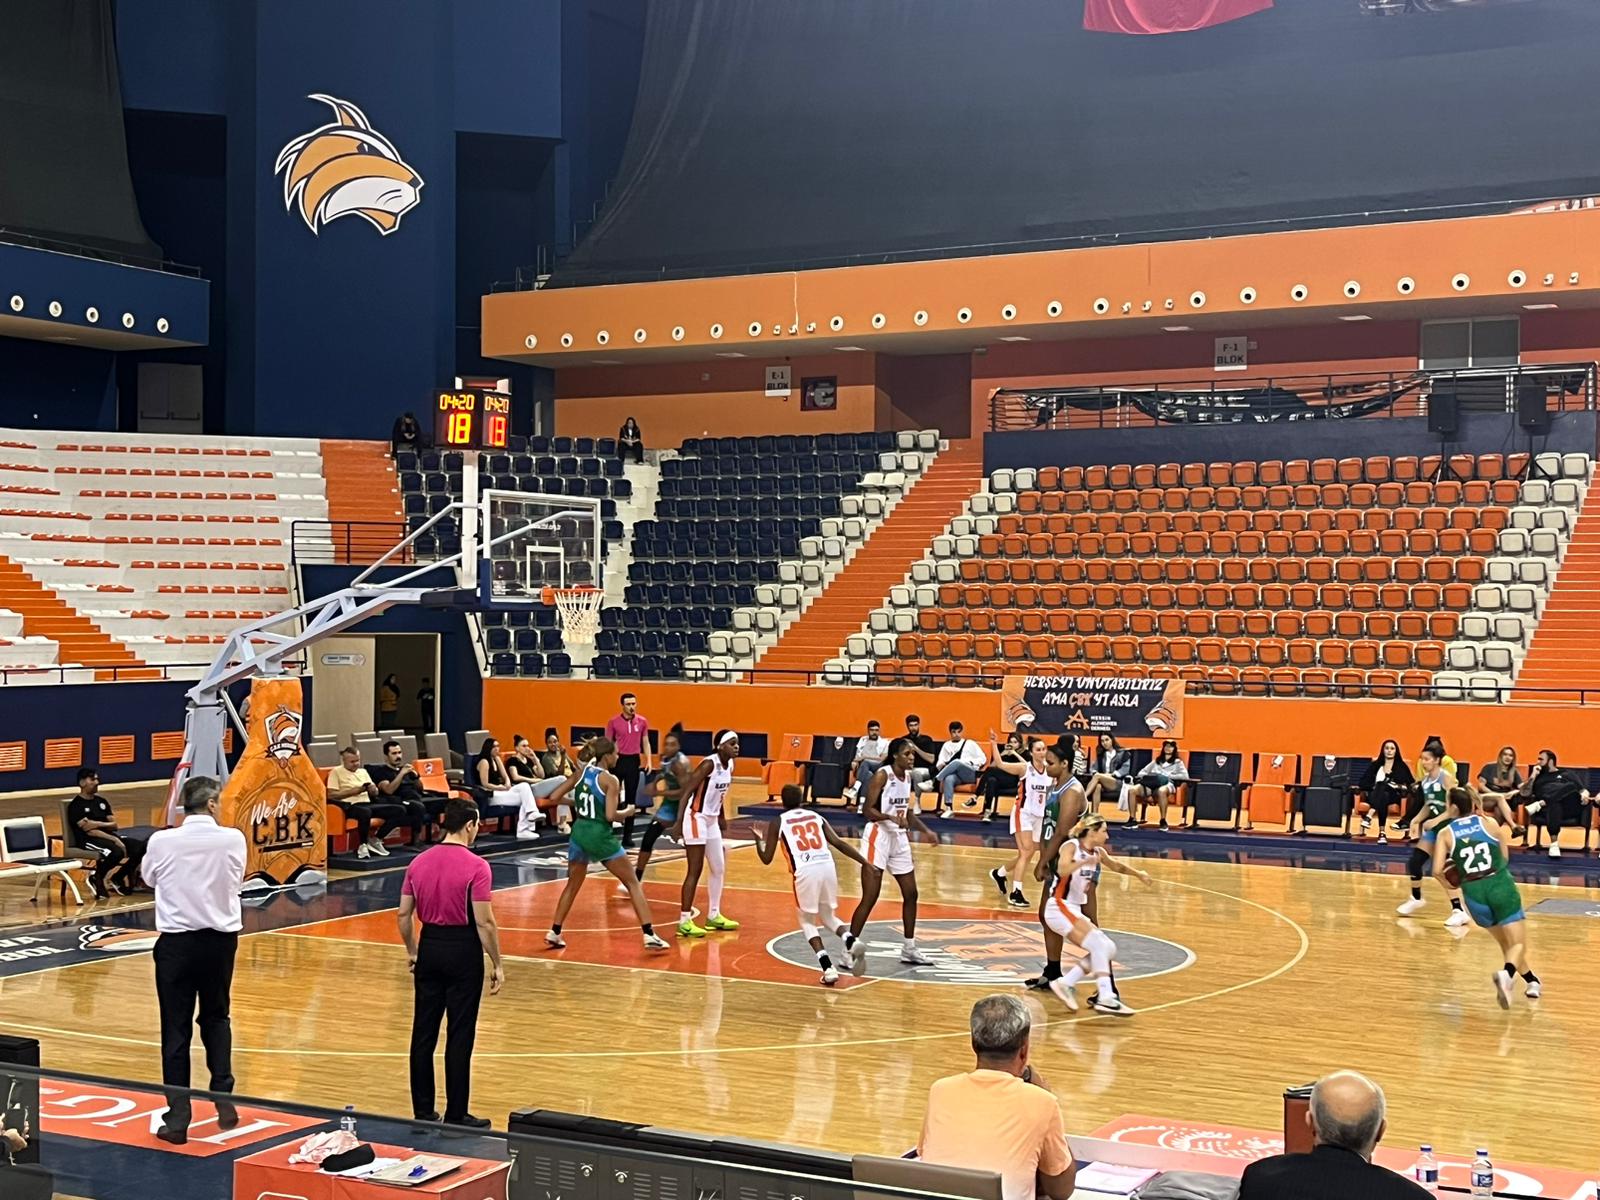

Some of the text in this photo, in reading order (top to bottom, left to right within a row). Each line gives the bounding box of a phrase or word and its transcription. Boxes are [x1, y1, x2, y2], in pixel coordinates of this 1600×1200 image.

[1216, 354, 1245, 365] BLOK
[1223, 343, 1238, 352] F-1
[439, 394, 475, 411] 04:20
[447, 412, 472, 444] 18
[488, 415, 507, 447] 18
[1042, 691, 1068, 706] AMA
[1109, 693, 1139, 708] ASLA
[250, 791, 298, 826] We Are
[578, 792, 596, 819] 31
[791, 821, 823, 852] 33
[1459, 841, 1493, 874] 23
